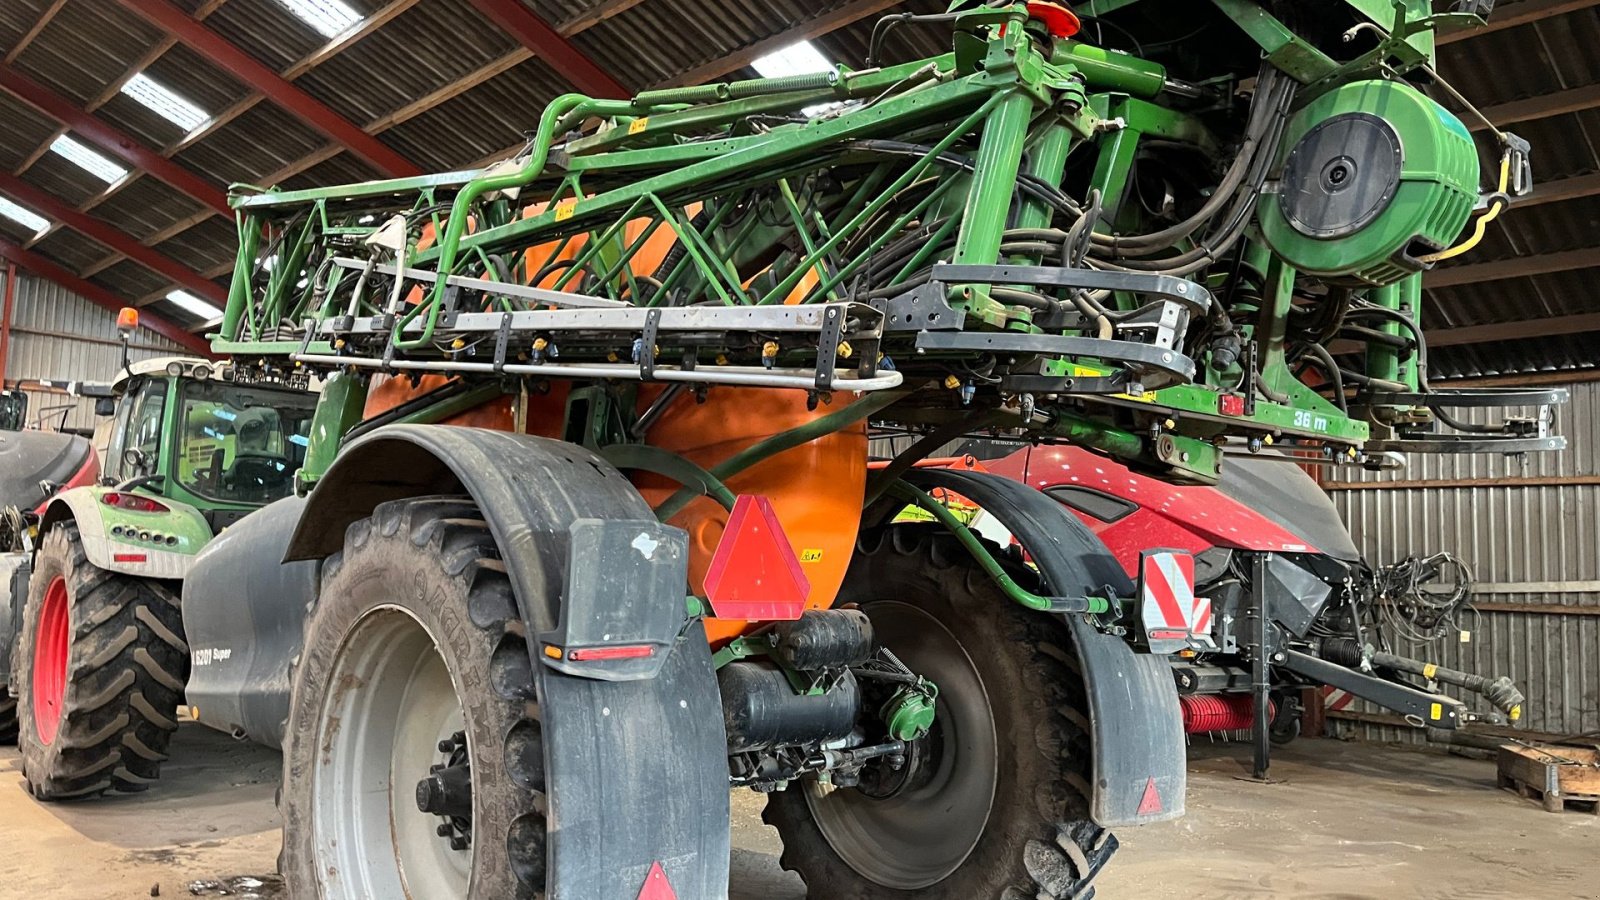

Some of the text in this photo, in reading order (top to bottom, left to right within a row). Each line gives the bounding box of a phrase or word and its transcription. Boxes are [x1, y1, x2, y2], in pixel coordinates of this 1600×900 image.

[1293, 410, 1327, 431] 36 m
[195, 648, 212, 666] 6201
[212, 647, 232, 662] Super
